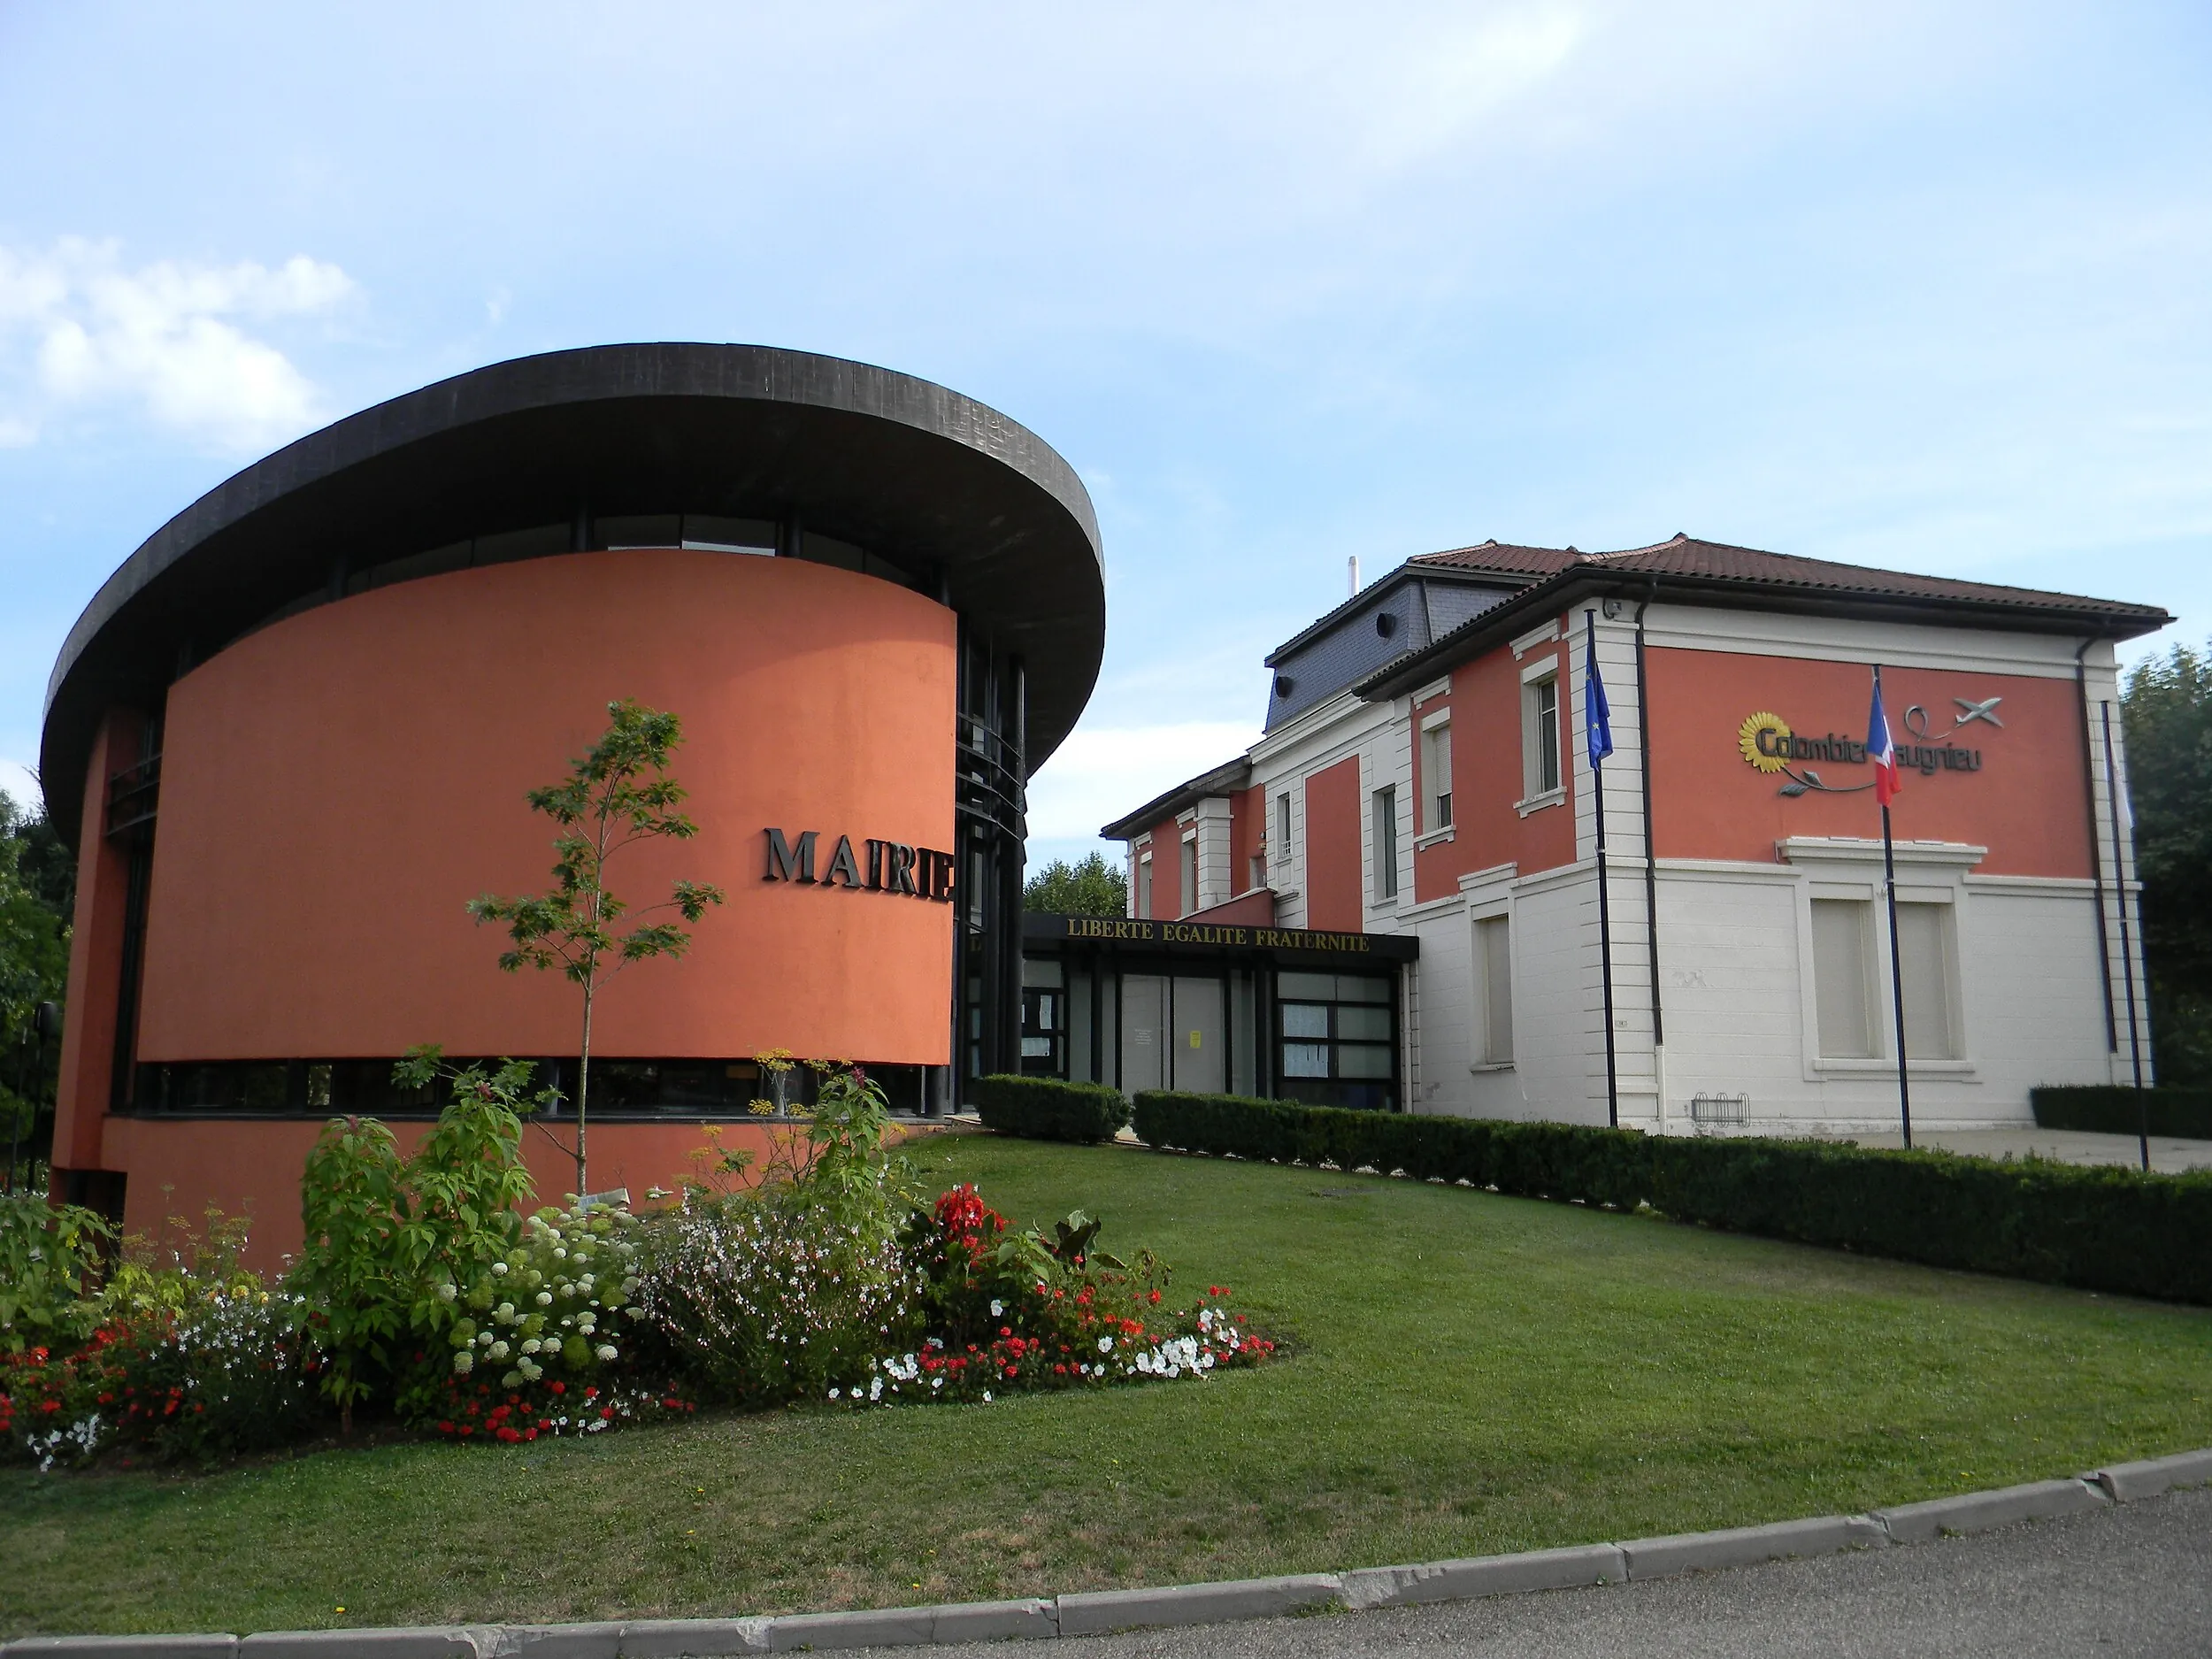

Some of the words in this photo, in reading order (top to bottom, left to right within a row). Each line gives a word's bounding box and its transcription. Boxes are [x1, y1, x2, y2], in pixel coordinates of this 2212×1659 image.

[1893, 741, 1980, 776] augnieu
[762, 827, 955, 902] MAIRIE
[1067, 918, 1154, 940] LIBERTE
[1162, 924, 1247, 945] EGALITE
[1255, 930, 1370, 952] FRATERNITE
